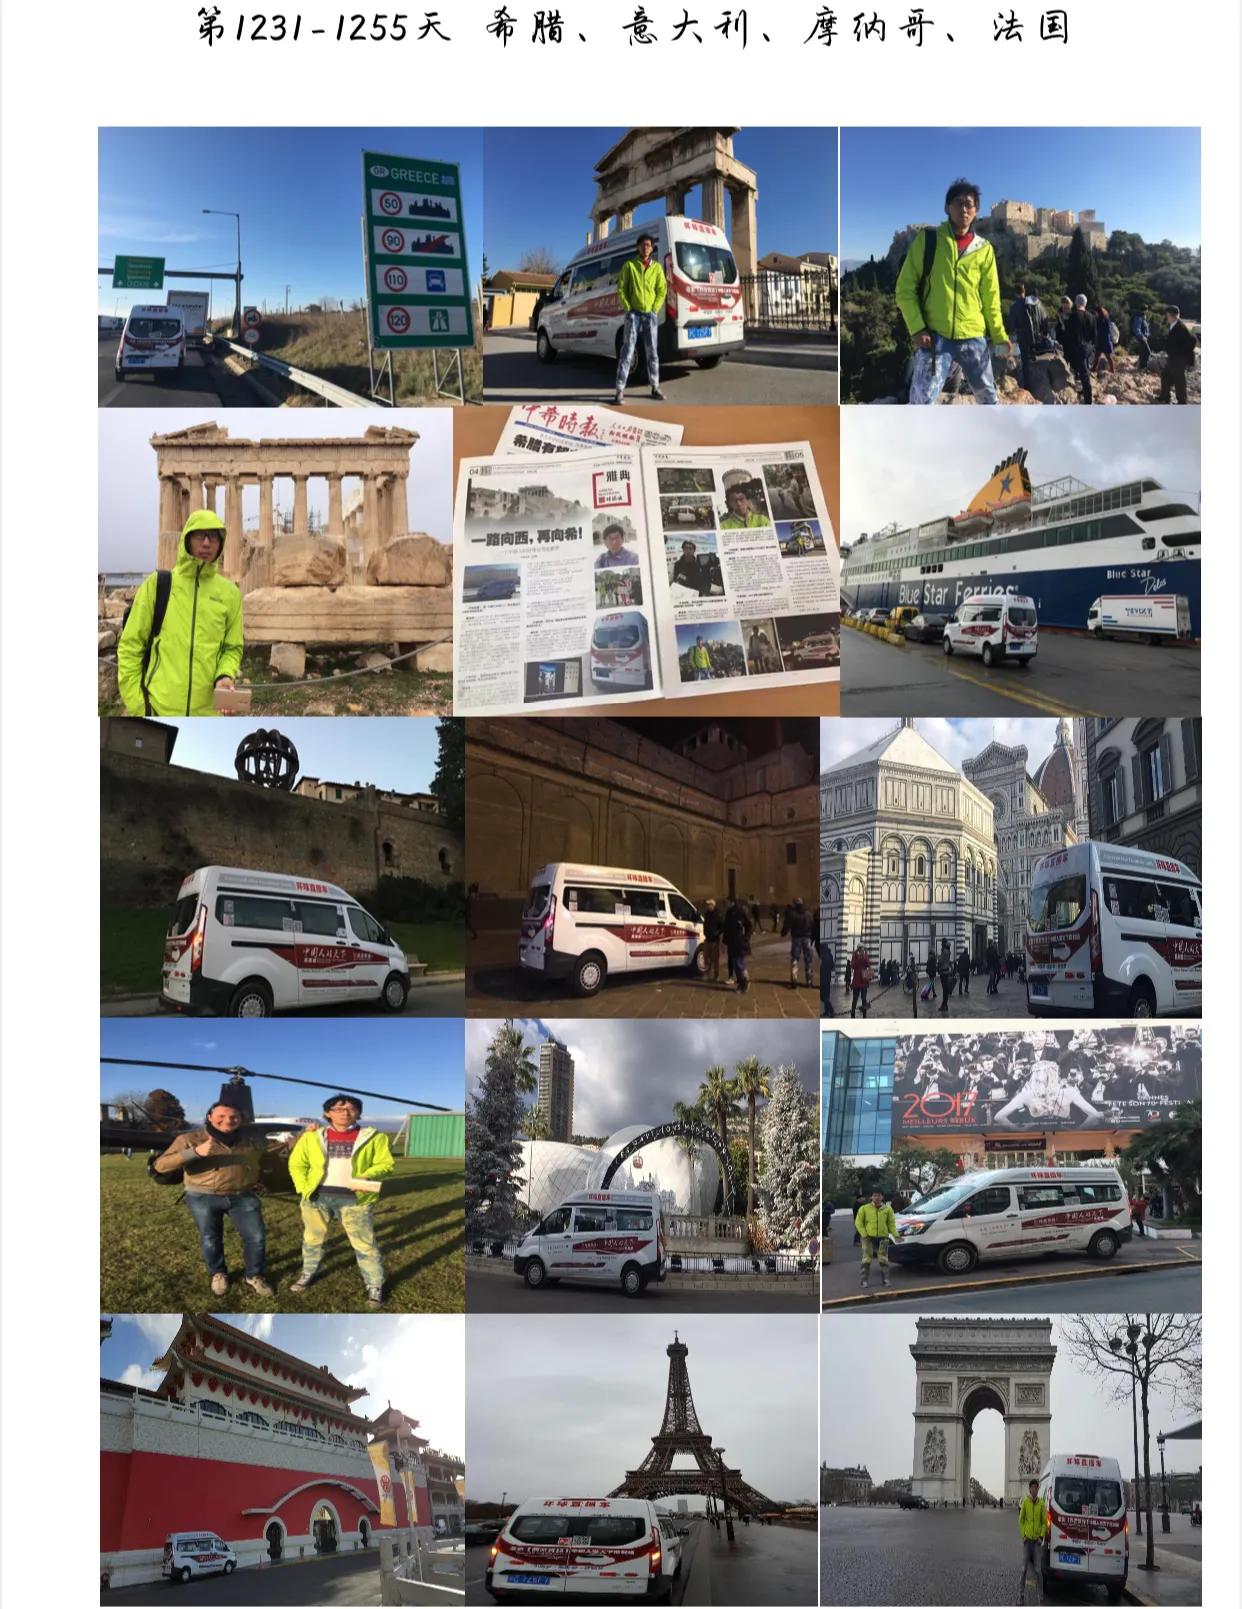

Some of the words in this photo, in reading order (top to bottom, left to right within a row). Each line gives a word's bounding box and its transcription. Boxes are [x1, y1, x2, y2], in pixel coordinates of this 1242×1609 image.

[391, 167, 439, 185] GREECE
[385, 198, 398, 209] 50
[387, 235, 400, 246] 90
[389, 274, 403, 285] 110
[391, 315, 407, 326] 120
[469, 468, 479, 477] 04
[606, 470, 630, 482] 雅典
[1106, 569, 1126, 579] Blue
[1130, 569, 1151, 578] Star
[899, 585, 920, 604] Blue
[924, 584, 948, 605] Star
[903, 1092, 978, 1118] 2017
